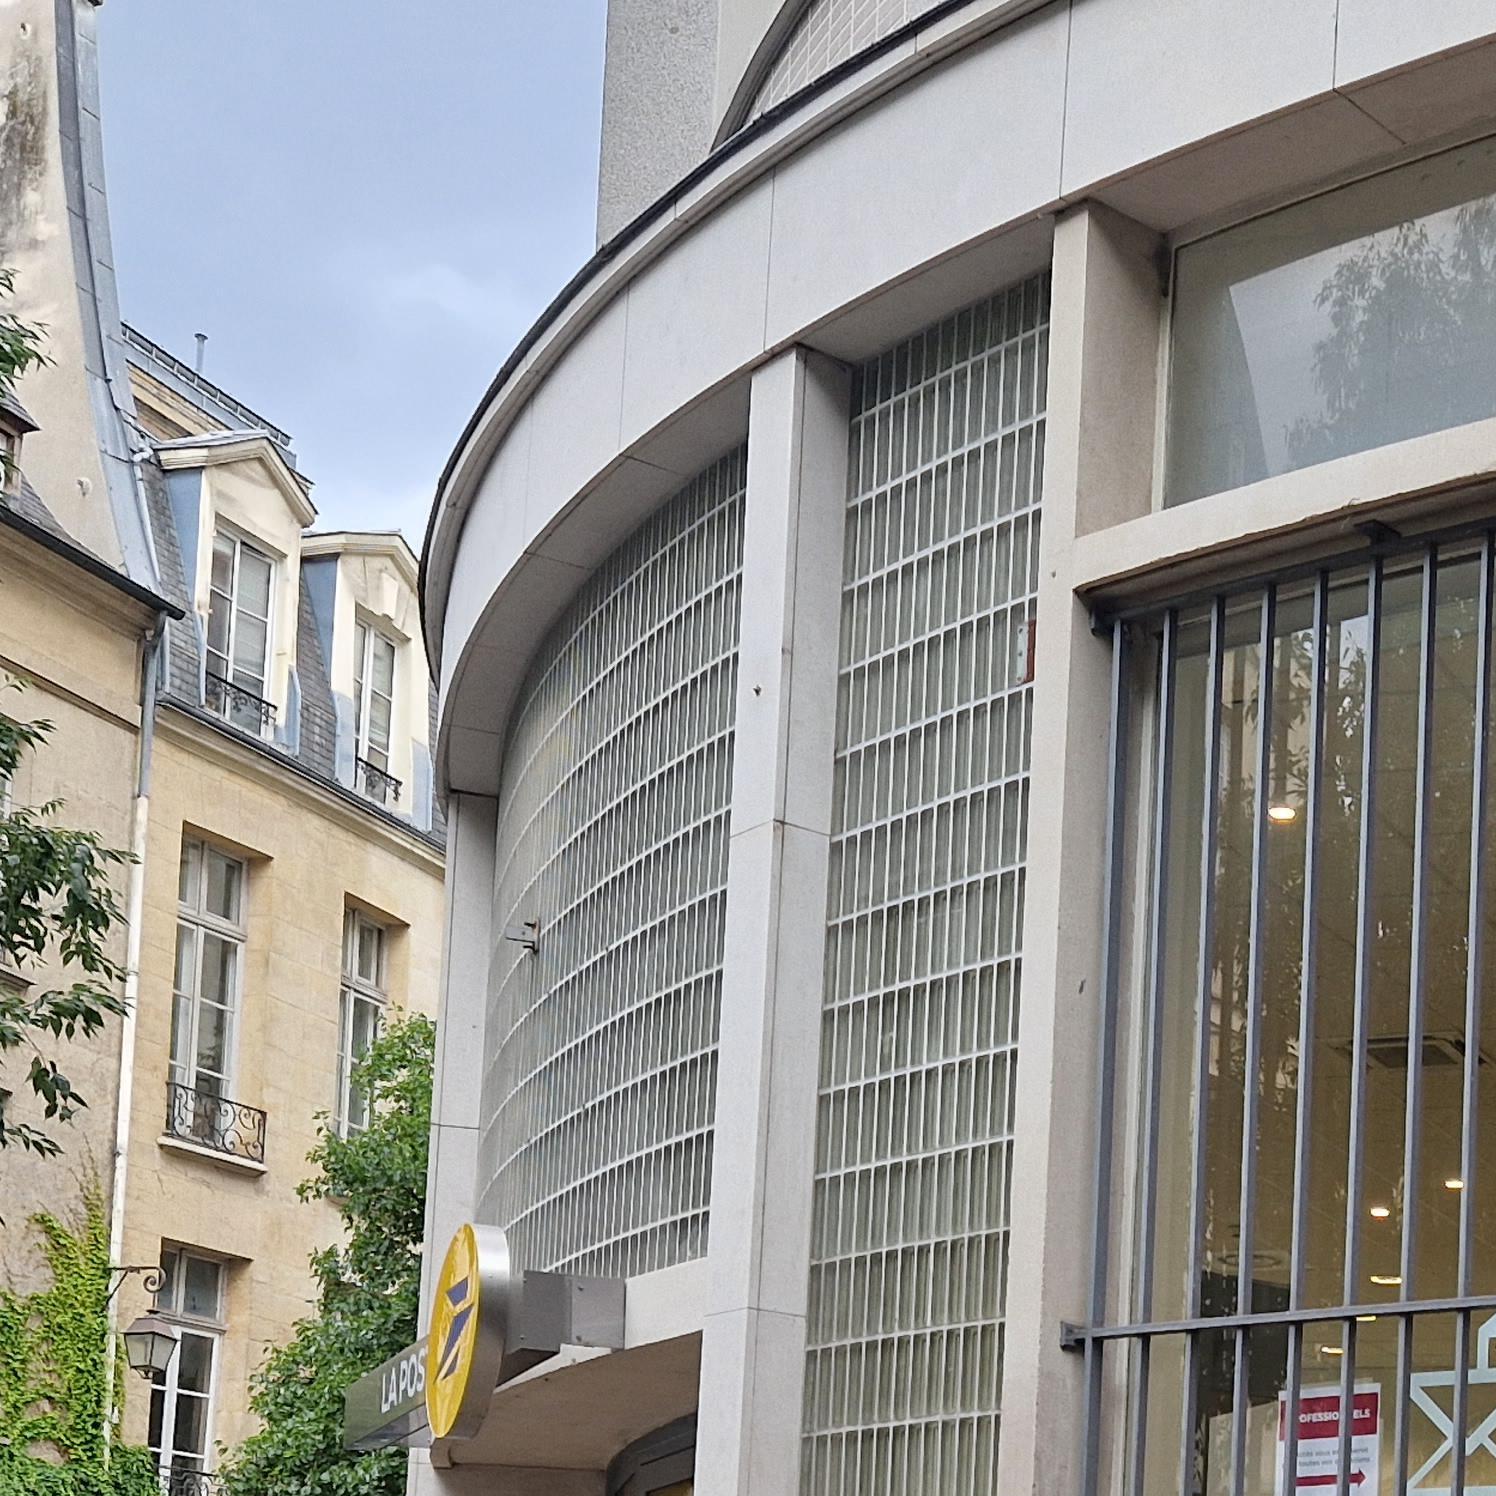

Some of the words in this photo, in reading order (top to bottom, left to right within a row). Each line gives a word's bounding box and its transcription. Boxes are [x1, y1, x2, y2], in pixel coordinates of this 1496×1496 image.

[381, 1367, 397, 1414] LA
[398, 1345, 428, 1404] POS
[1298, 1408, 1371, 1423] OFESSIOELS
